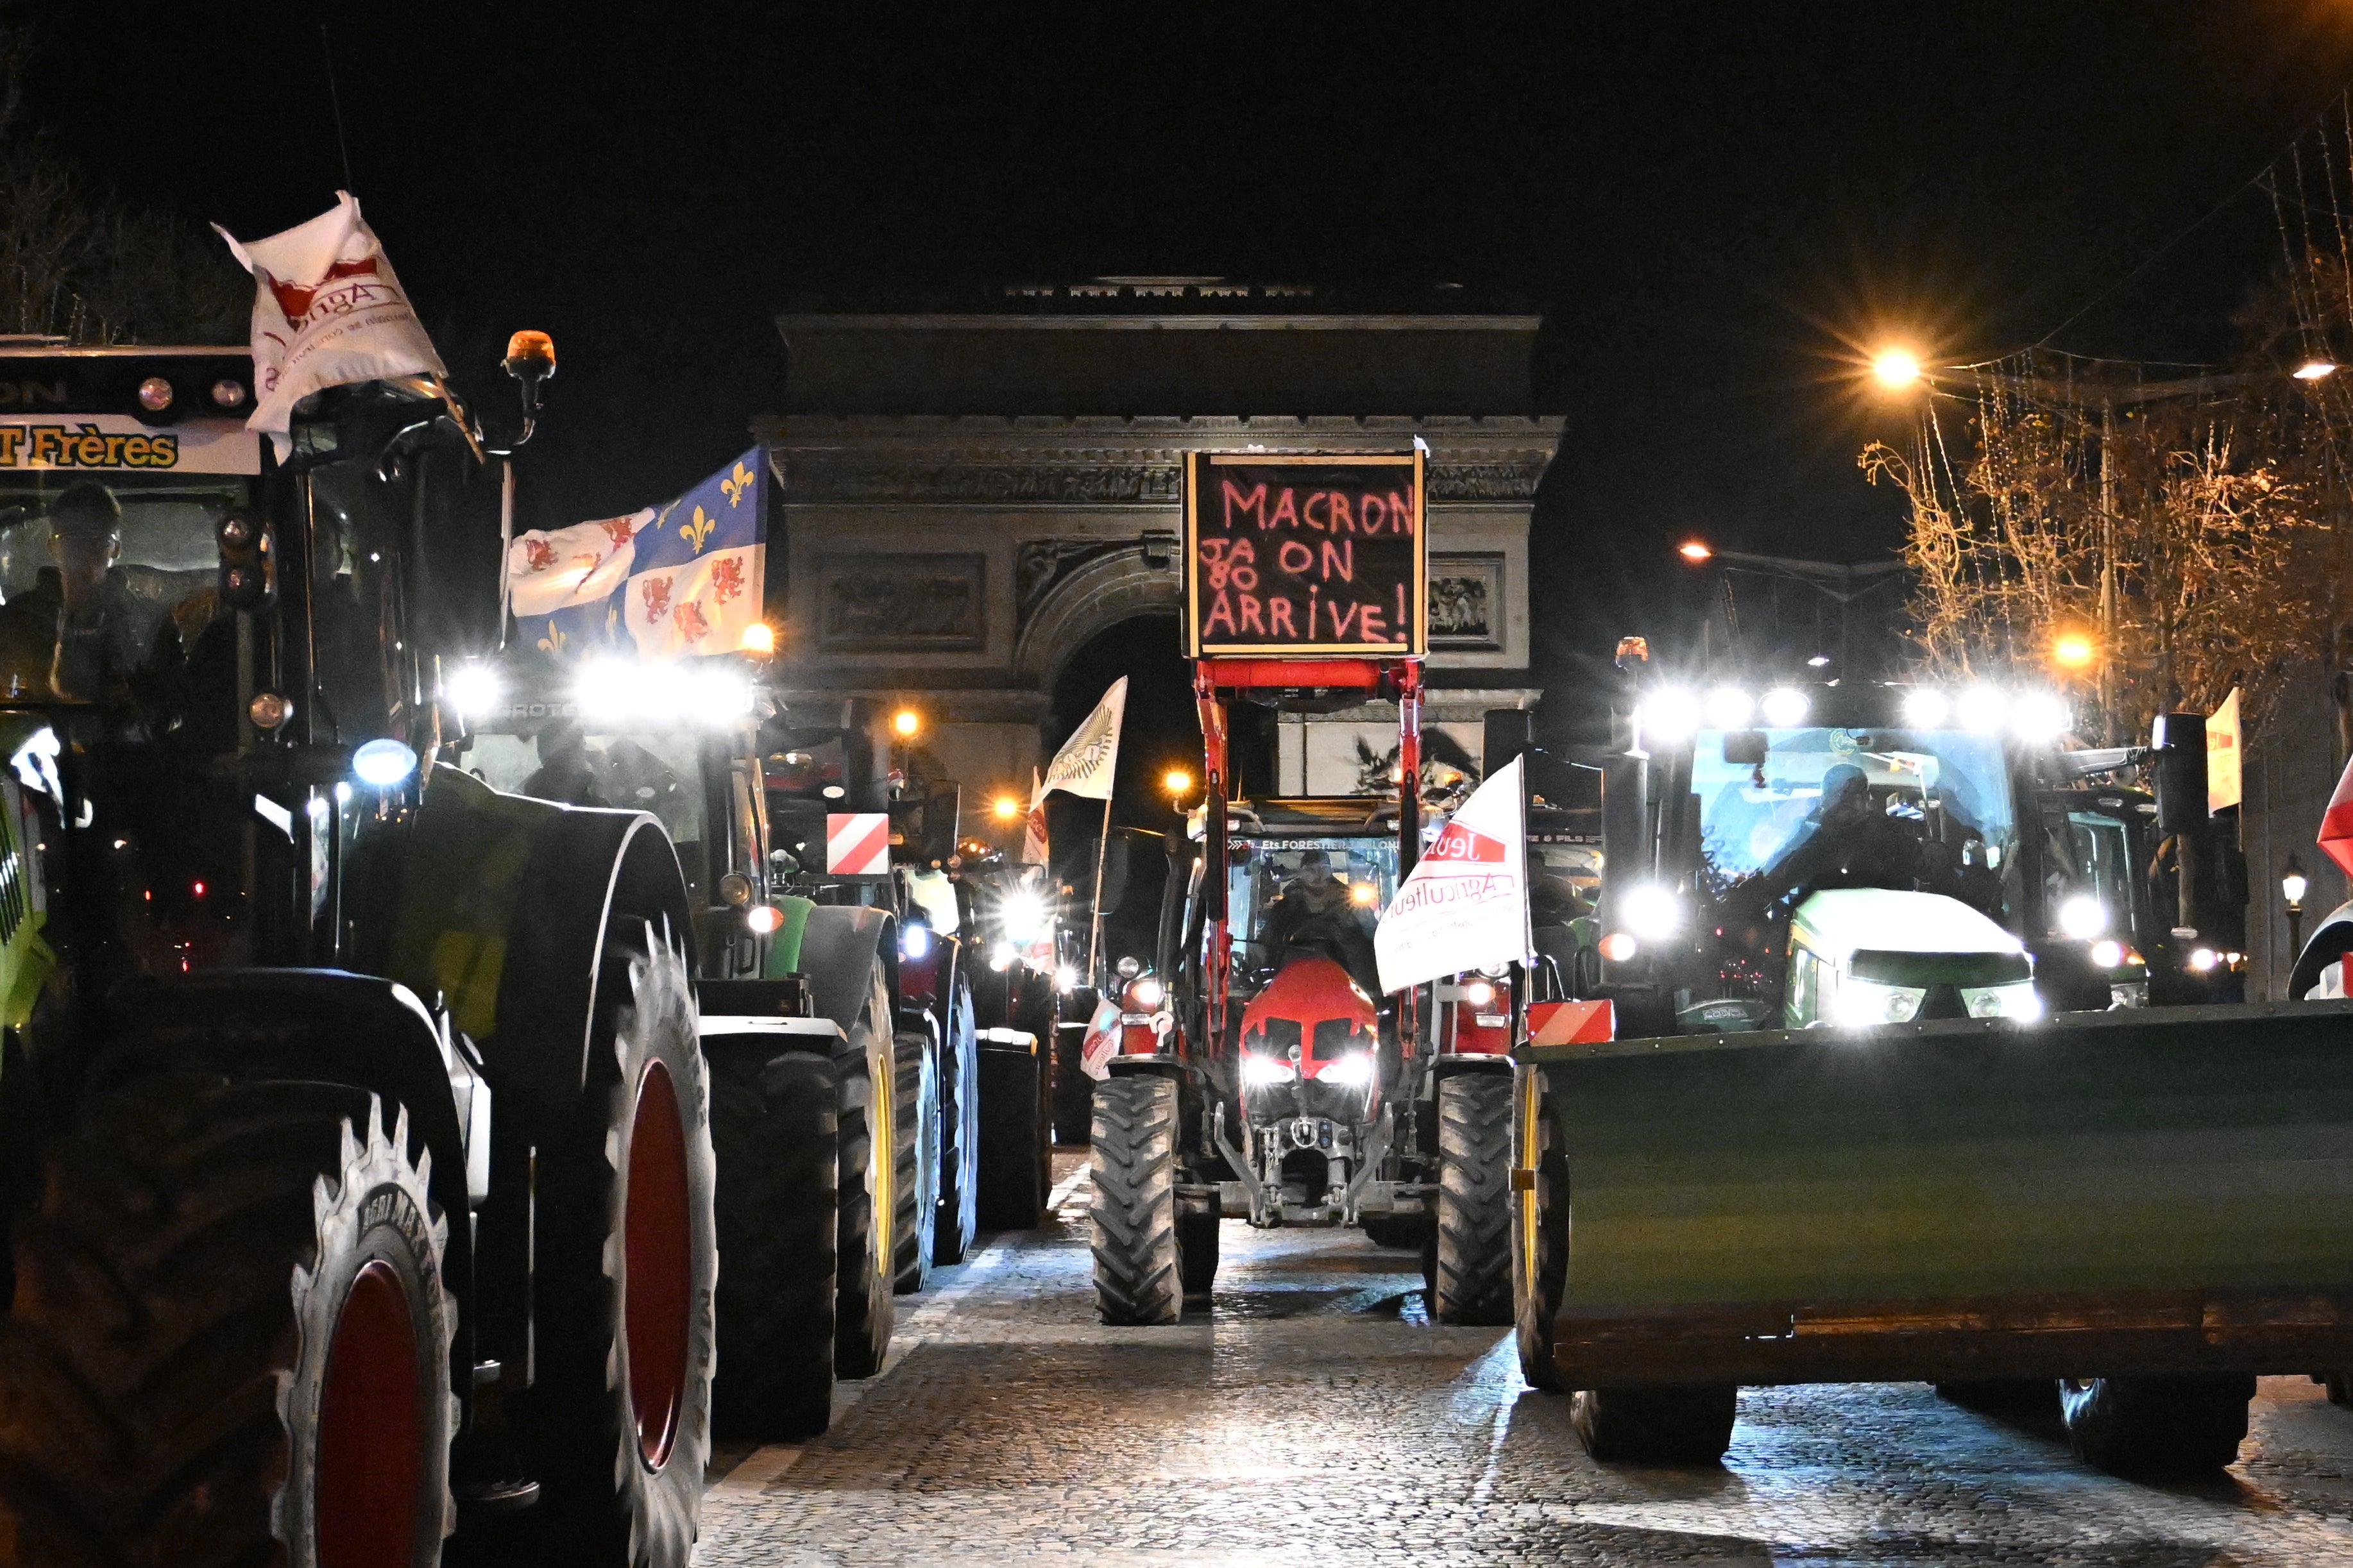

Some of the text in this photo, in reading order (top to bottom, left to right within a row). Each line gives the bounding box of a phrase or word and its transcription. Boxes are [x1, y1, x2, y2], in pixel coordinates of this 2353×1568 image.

[28, 423, 178, 468] Frères
[1221, 480, 1413, 535] MACRON
[1279, 539, 1354, 582] ON
